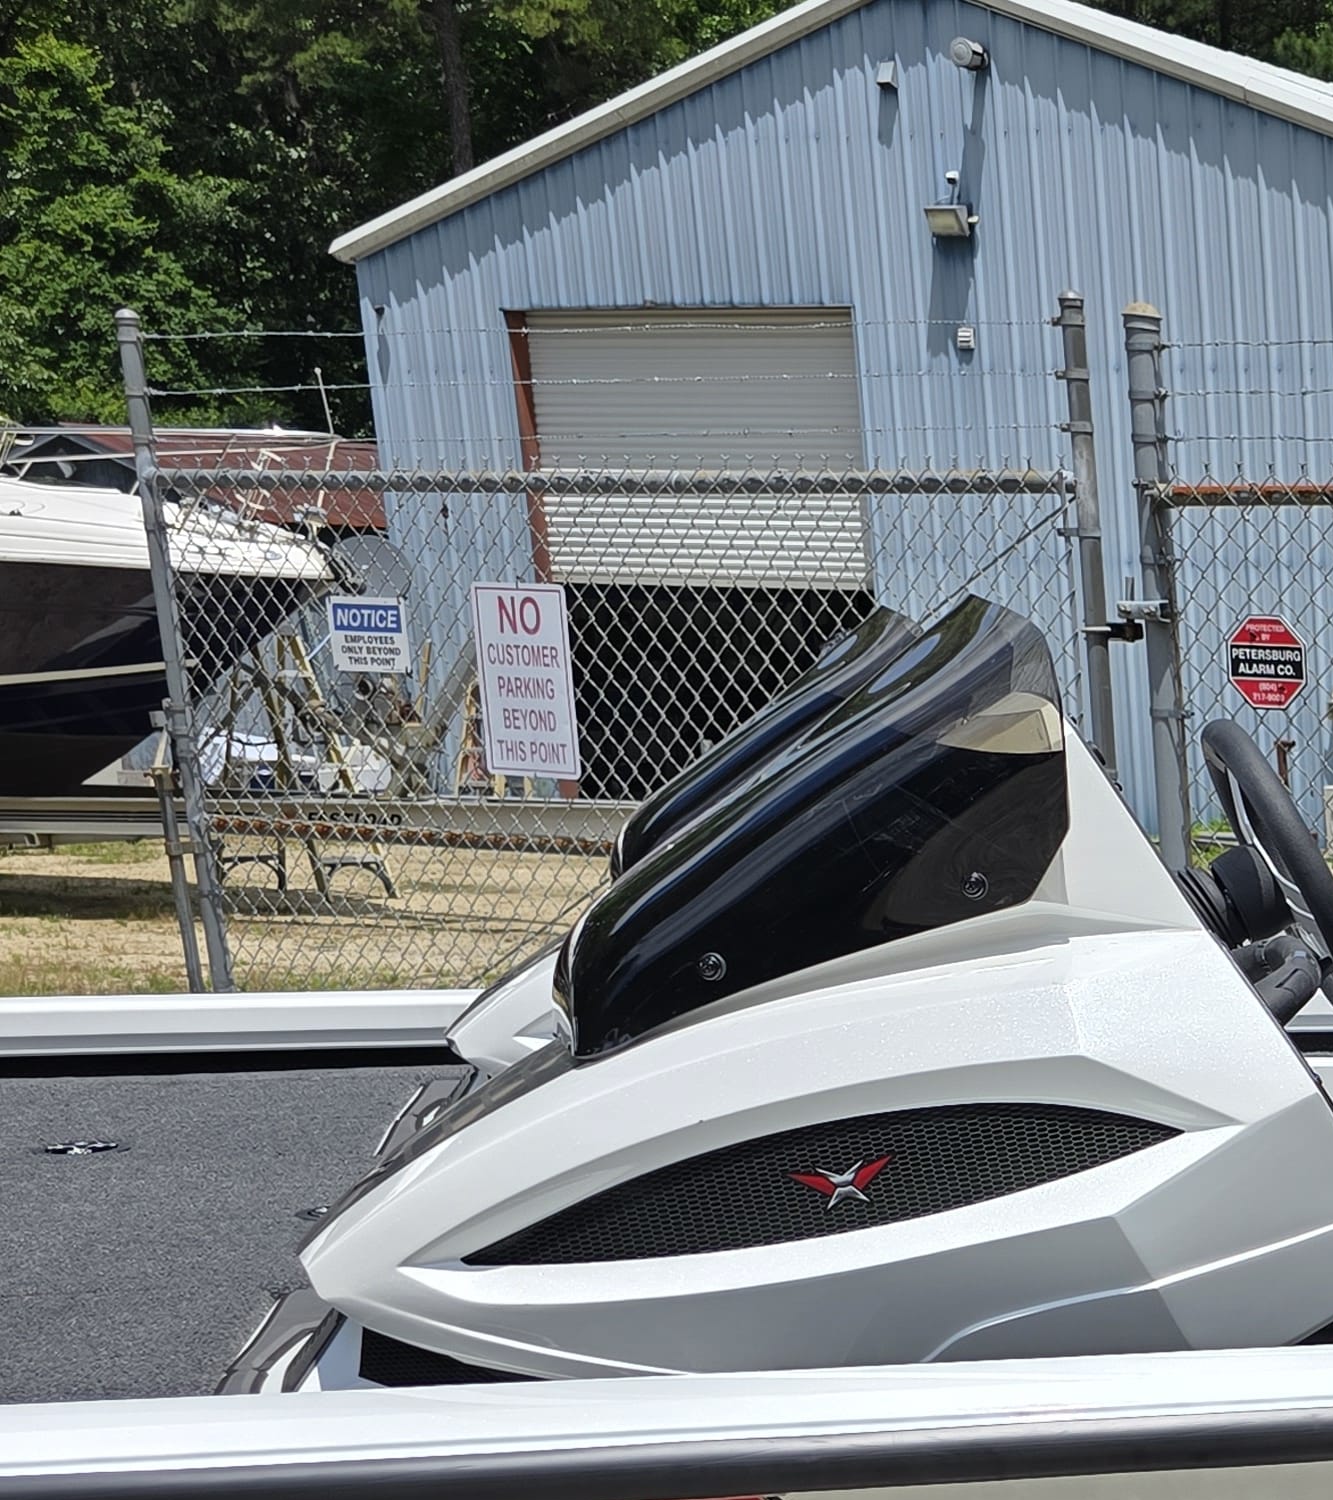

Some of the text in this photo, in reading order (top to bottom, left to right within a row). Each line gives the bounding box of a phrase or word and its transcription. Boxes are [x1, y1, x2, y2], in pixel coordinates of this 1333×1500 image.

[336, 608, 398, 628] NOTICE
[497, 595, 541, 636] NO
[1245, 623, 1286, 633] PROTECTED
[344, 634, 396, 646] EMPLOYEES
[341, 645, 401, 656] ONLY BEYOND
[487, 643, 560, 669] CUSTOMER
[1231, 648, 1301, 663] PETERSBURG
[348, 656, 396, 667] THIS POINT
[1238, 662, 1296, 676] ALARM CO.
[497, 675, 555, 701] PARKING
[503, 708, 557, 733] BEYOND
[497, 739, 568, 765] THIS POINT
